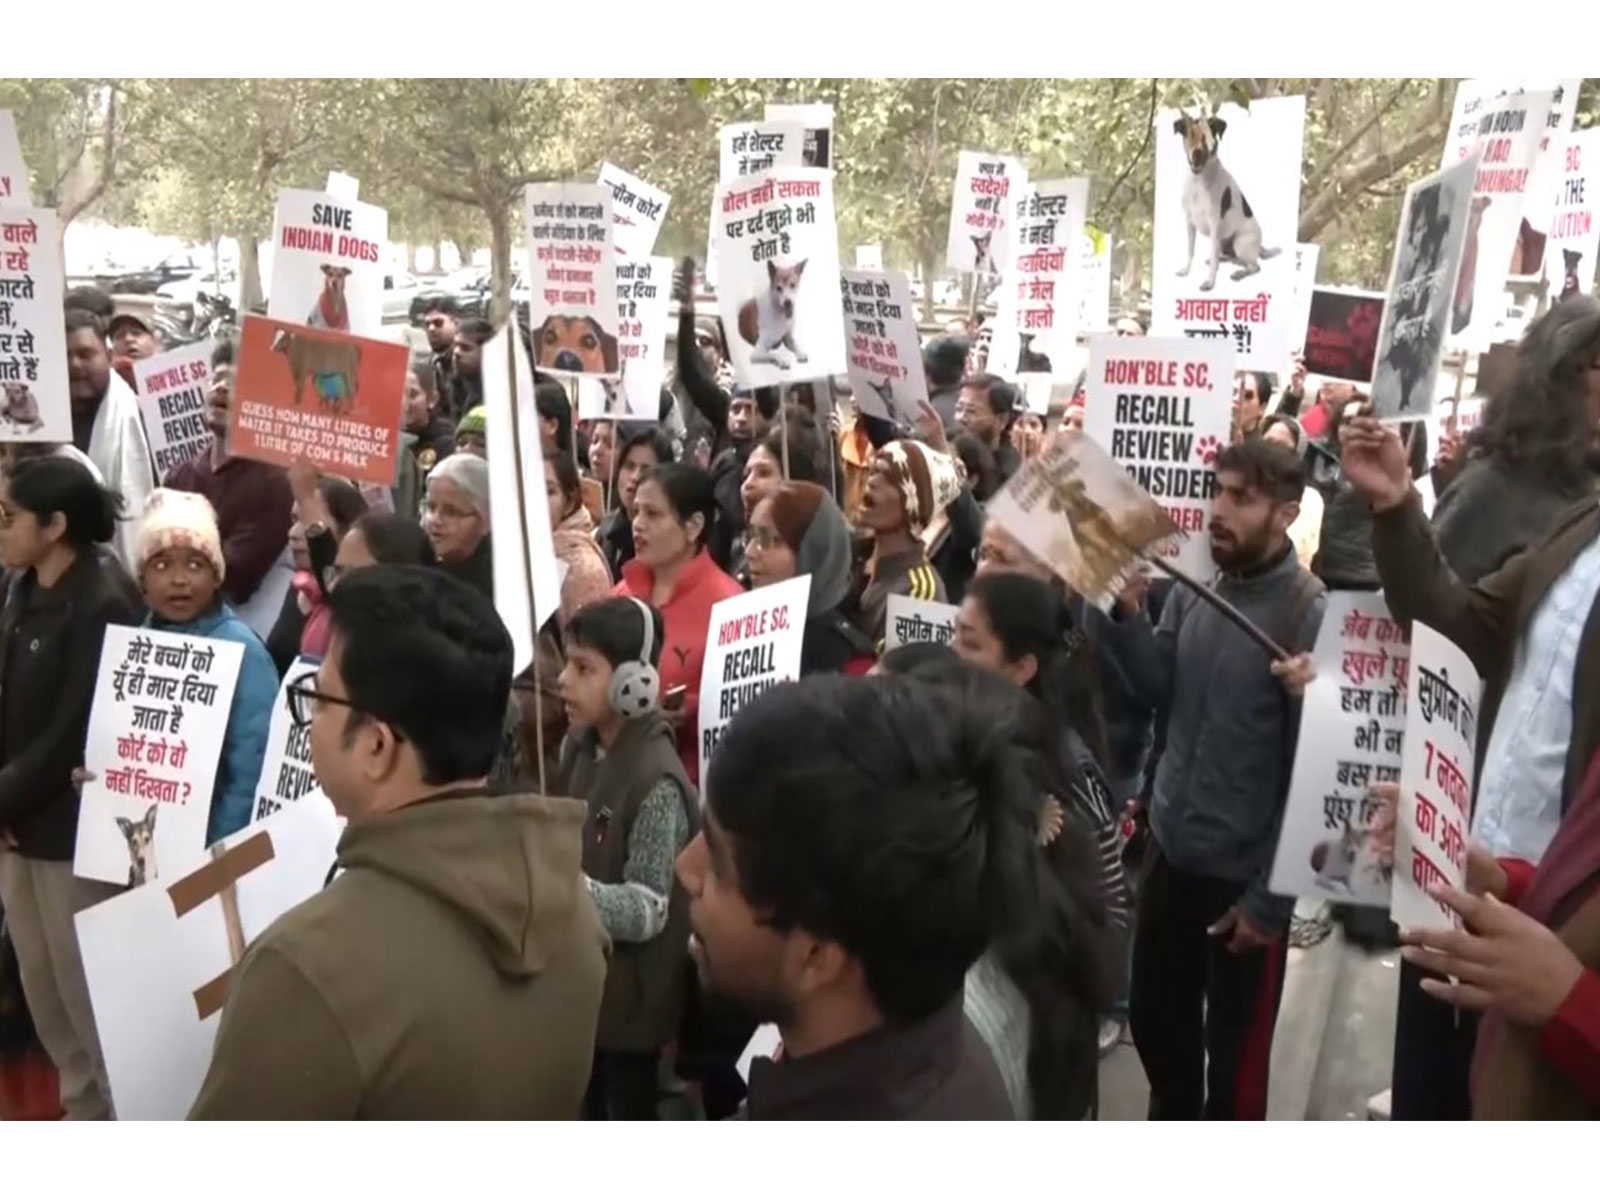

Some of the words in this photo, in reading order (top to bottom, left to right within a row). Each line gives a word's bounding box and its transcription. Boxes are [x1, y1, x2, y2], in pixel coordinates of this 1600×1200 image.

[749, 129, 784, 152] शेल्टर
[750, 178, 776, 205] नहीं
[777, 180, 820, 199] सकता
[971, 175, 1009, 198] स्वदेशी
[312, 203, 352, 231] SAVE
[636, 196, 663, 221] कोर्ट
[726, 219, 744, 239] पर
[746, 209, 764, 234] दर्द
[765, 203, 792, 234] मुझे
[796, 201, 815, 224] भी
[1029, 191, 1068, 217] शेल्टर
[2, 217, 38, 244] वाले
[281, 226, 333, 254] INDIAN
[338, 235, 378, 262] DOGS
[751, 239, 777, 262] होता
[780, 231, 791, 255] है
[1029, 217, 1058, 245] नहीं
[6, 247, 29, 272] रहे
[633, 281, 657, 299] दिया
[1029, 275, 1055, 301] जेल
[1025, 302, 1055, 329] डालो
[1175, 298, 1230, 322] आवारा
[1232, 291, 1272, 323] नहीं
[17, 328, 34, 354] से
[24, 357, 39, 381] हैं
[1104, 359, 1179, 387] HON'BLE
[1183, 362, 1214, 391] SC,
[276, 409, 299, 423] HOW
[301, 412, 332, 430] MANY
[334, 419, 371, 438] LITRES
[374, 427, 390, 441] OF
[1114, 393, 1195, 428] RECALL
[285, 424, 318, 443] TAKES
[337, 436, 389, 457] PRODUCE
[1111, 427, 1195, 463] REVIEW
[342, 451, 368, 468] MILK
[717, 610, 768, 647] HON'BLE
[770, 604, 791, 632] SC,
[895, 613, 932, 644] सुप्रीम
[935, 623, 956, 645] को
[1341, 609, 1371, 640] जेब
[127, 635, 153, 665] मेरे
[154, 642, 193, 671] बच्चों
[191, 646, 215, 675] को
[722, 641, 775, 684] RECALL
[1341, 646, 1389, 685] खुले
[112, 660, 129, 702] यूँ
[127, 666, 147, 695] ही
[146, 674, 180, 701] मार
[180, 674, 219, 707] दिया
[1417, 664, 1459, 732] सुप्रीम
[1339, 686, 1372, 713] हम
[1377, 684, 1399, 716] तो
[131, 704, 169, 733] जाता
[169, 704, 184, 735] है
[1354, 718, 1381, 752] भी
[117, 732, 146, 762] कोर्ट
[146, 737, 168, 766] को
[169, 739, 188, 769] वो
[105, 766, 135, 795] नहीं
[134, 769, 180, 803] दिखता
[181, 782, 192, 806] ?
[276, 762, 320, 801] REVIE
[1337, 760, 1372, 788] बस
[1323, 791, 1356, 830] पूंछ
[1415, 791, 1438, 842] का
